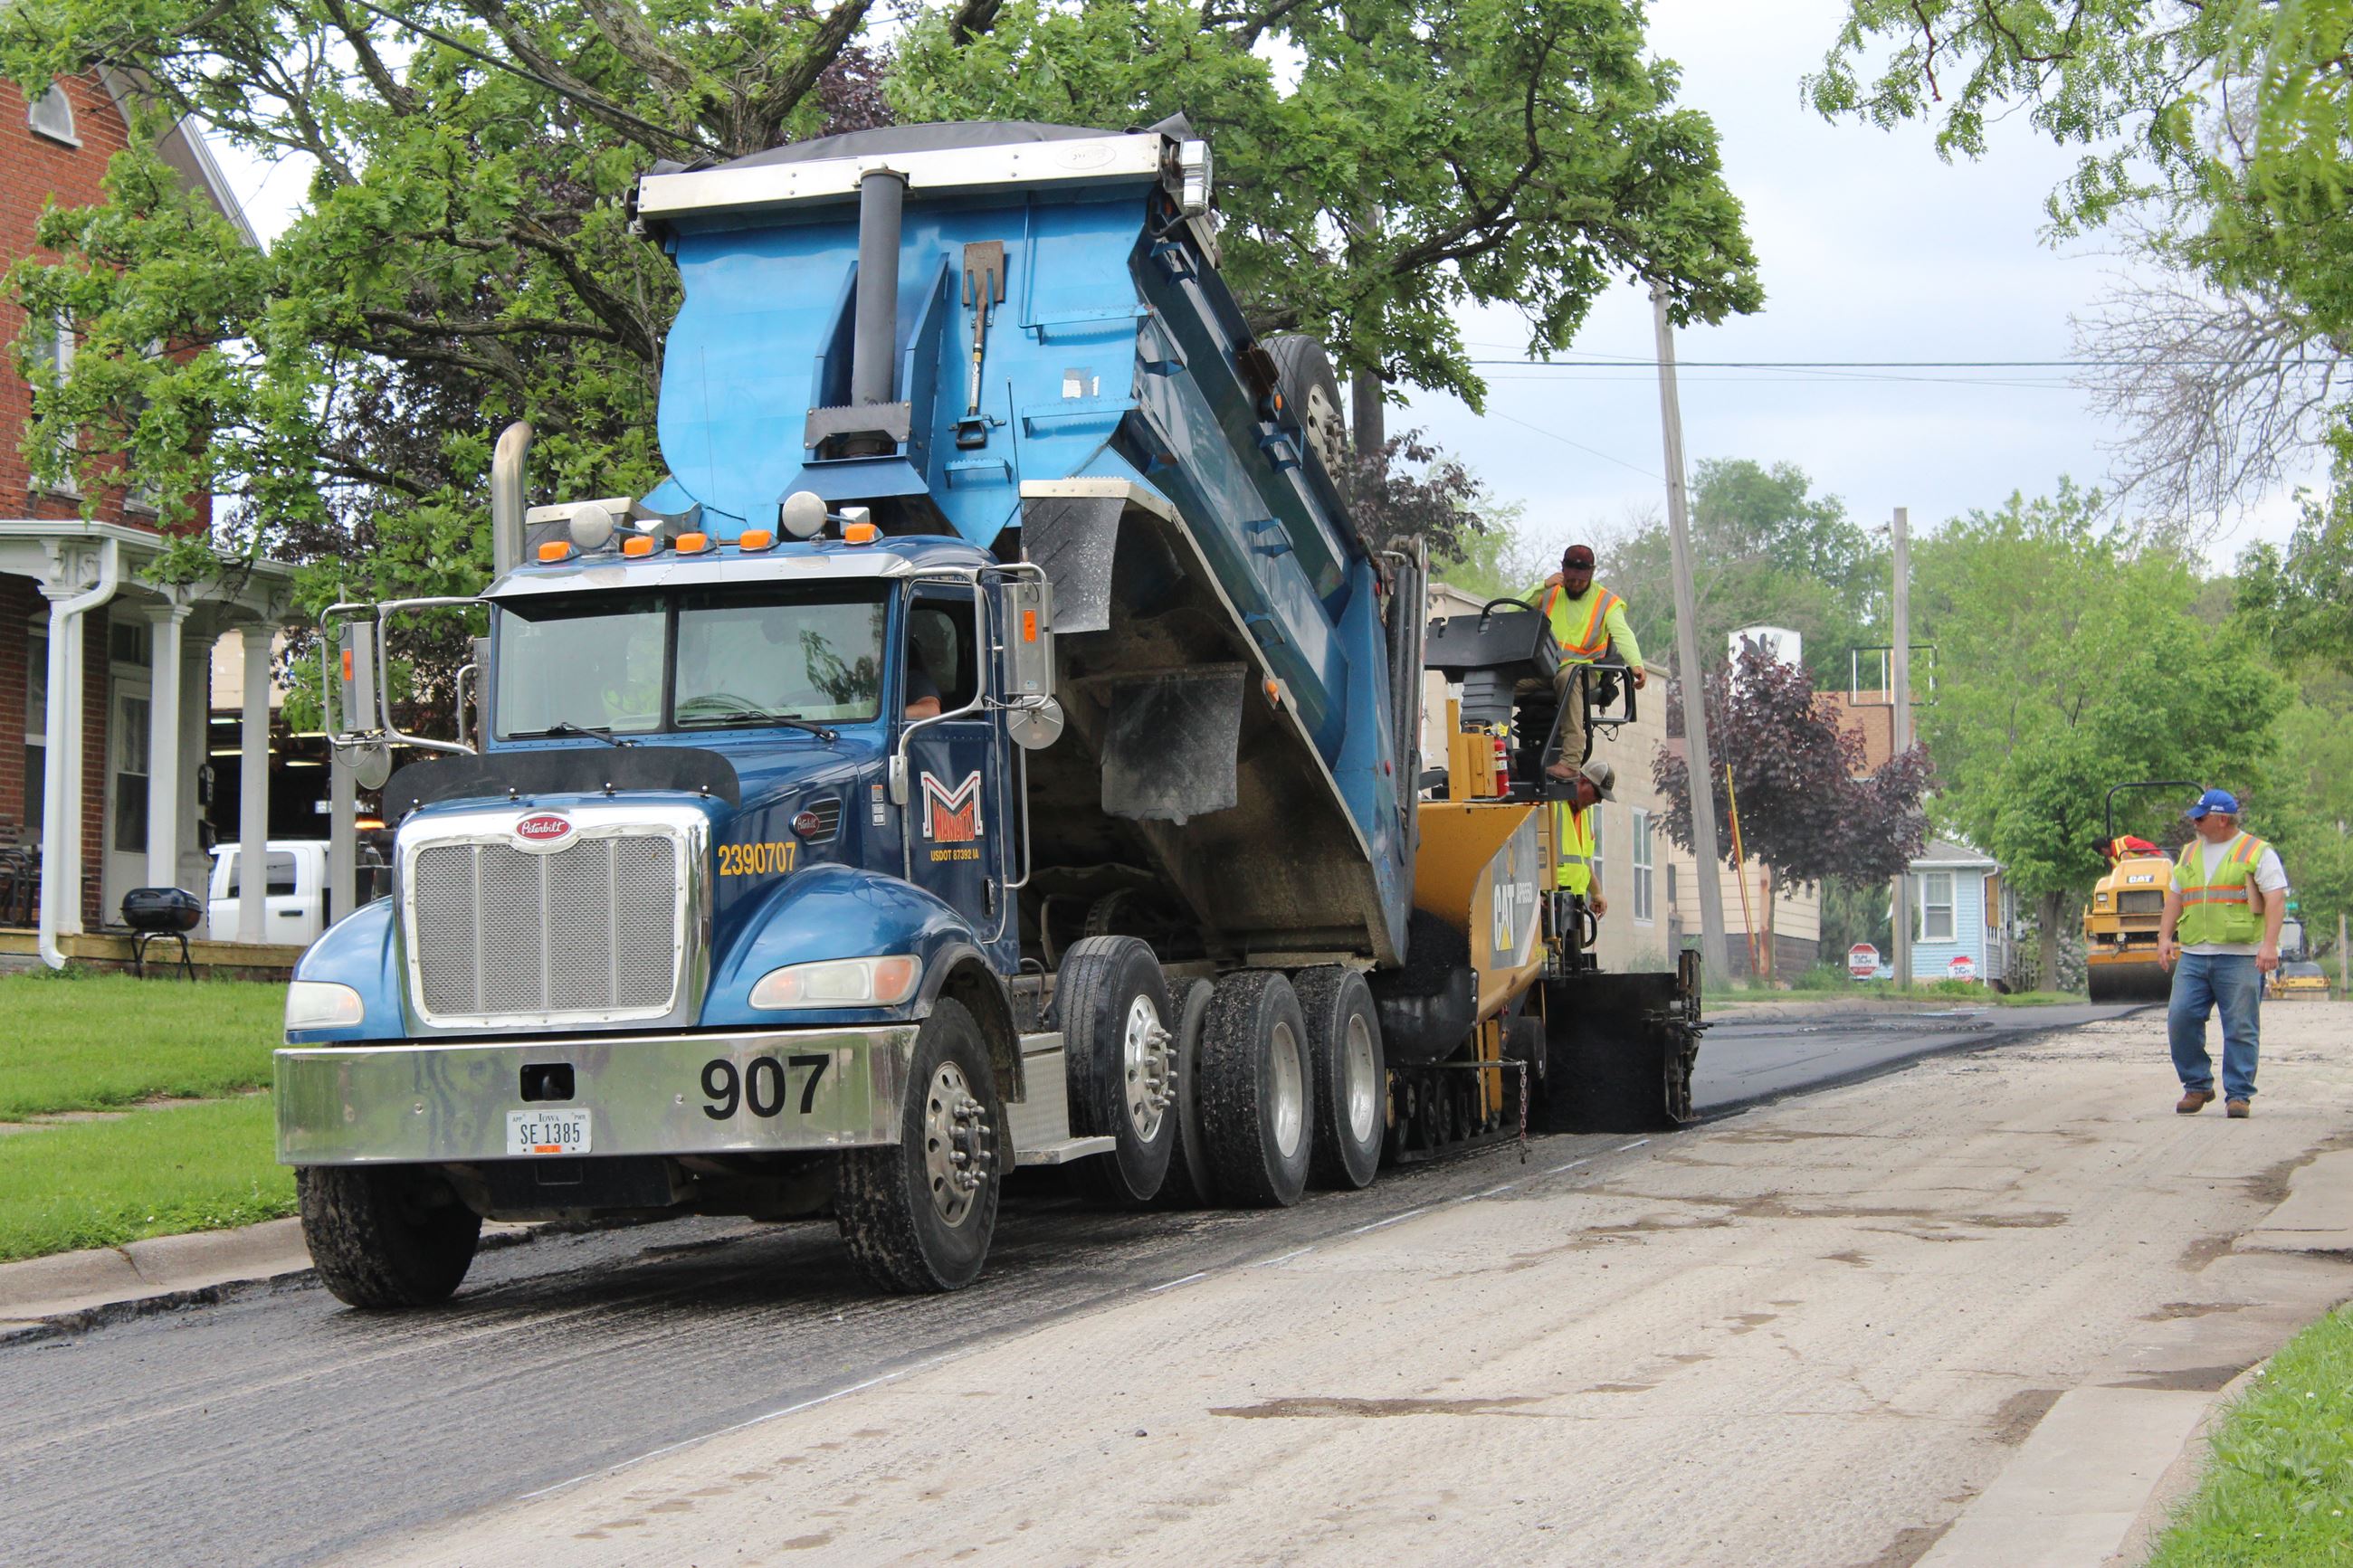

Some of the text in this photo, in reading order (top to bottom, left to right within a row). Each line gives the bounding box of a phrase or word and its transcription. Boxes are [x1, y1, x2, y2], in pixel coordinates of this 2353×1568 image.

[521, 822, 565, 834] Peterbilt
[719, 842, 795, 876] 2390707
[930, 850, 952, 861] USDOT
[953, 849, 971, 860] 87392
[2129, 875, 2151, 883] CAT
[1494, 884, 1514, 951] CAT
[700, 1054, 829, 1120] 907
[520, 1122, 580, 1145] SE 1385
